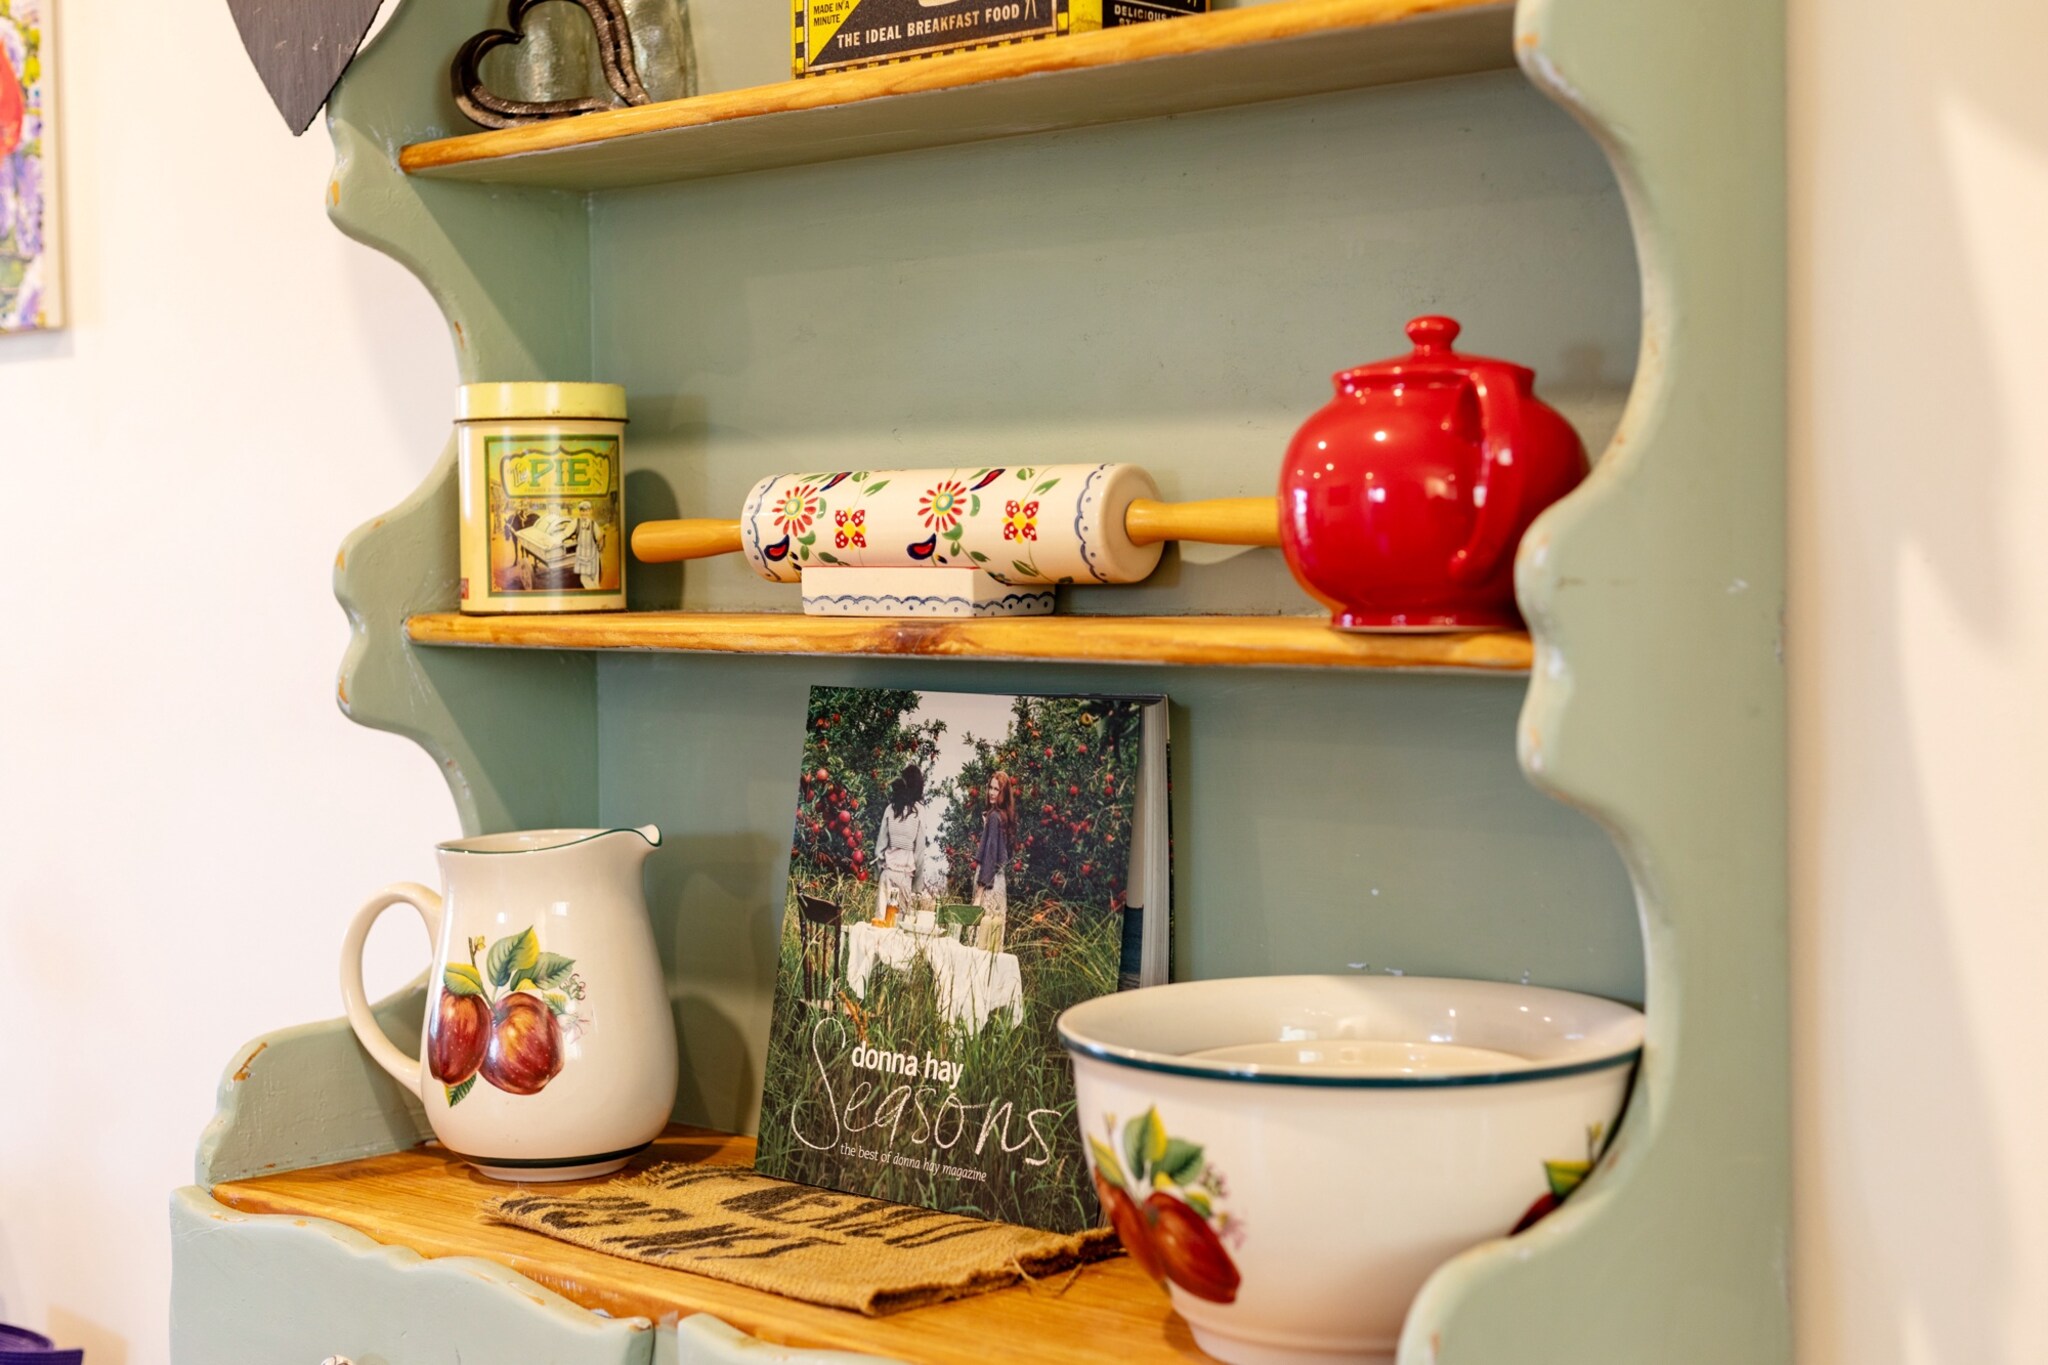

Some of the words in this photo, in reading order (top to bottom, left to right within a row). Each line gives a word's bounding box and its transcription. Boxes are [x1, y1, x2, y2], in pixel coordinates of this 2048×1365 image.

[813, 14, 841, 26] MINUTE
[814, 3, 834, 15] MADE
[835, 1, 844, 12] IN
[844, 0, 850, 10] A
[1114, 4, 1167, 21] DELICIOUS
[837, 31, 860, 48] THE
[865, 25, 902, 44] IDEAL
[907, 10, 980, 37] BREAKFAST
[985, 3, 1020, 23] FOOD
[529, 458, 592, 487] PIE
[851, 1040, 919, 1077] donna
[924, 1050, 964, 1090] hay
[791, 1016, 1063, 1166] Seasons
[840, 1142, 856, 1157] the
[858, 1145, 878, 1161] best
[881, 1149, 892, 1163] of
[893, 1152, 921, 1168] donna
[923, 1157, 941, 1176] hay
[942, 1163, 987, 1182] magazine
